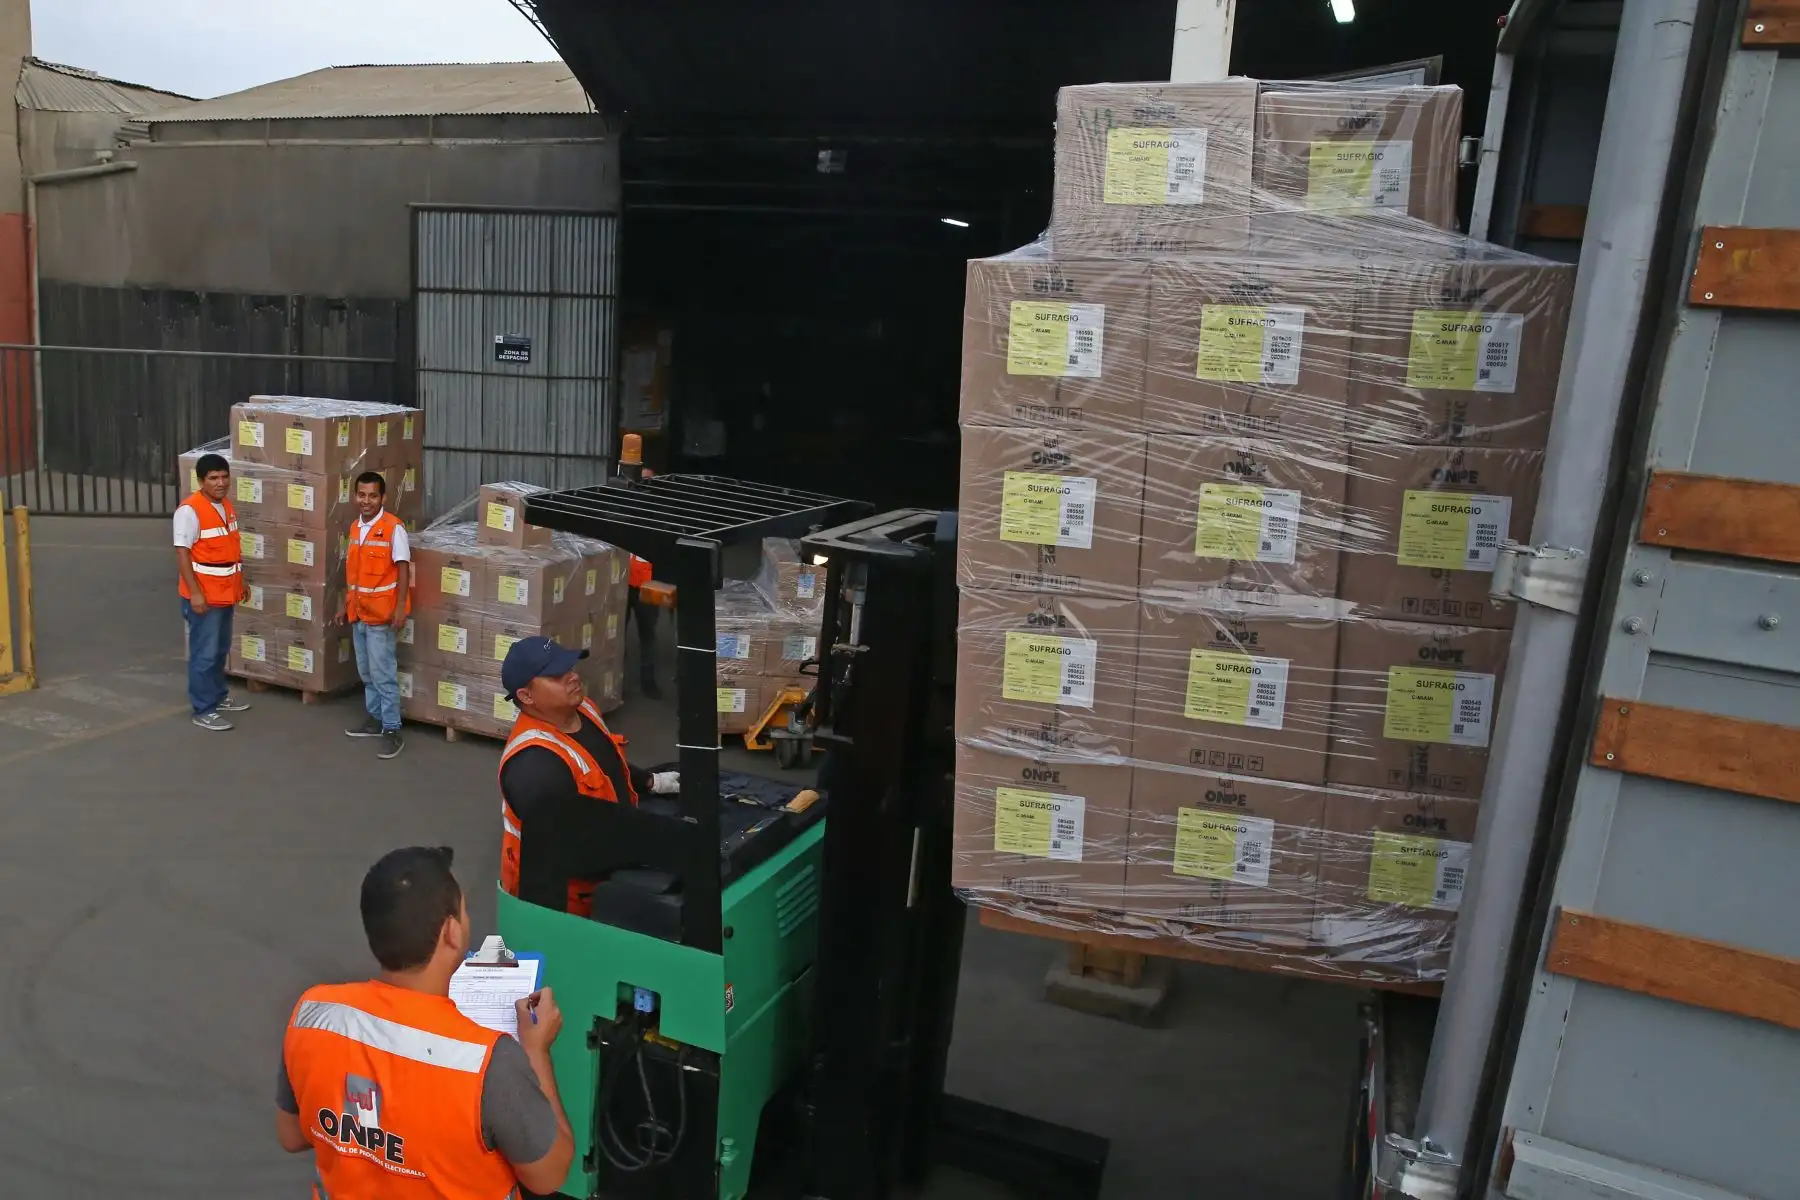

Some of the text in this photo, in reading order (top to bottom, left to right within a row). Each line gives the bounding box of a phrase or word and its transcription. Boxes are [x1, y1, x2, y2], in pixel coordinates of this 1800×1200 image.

[1337, 153, 1384, 161] SUFRAGIO
[1035, 314, 1078, 322] SUFRAGIO
[1228, 318, 1276, 327] SUFRAGIO
[1441, 324, 1492, 333] SUFRAGIO
[1432, 469, 1478, 483] ONPE
[1028, 485, 1070, 494] SUFRAGIO
[1226, 498, 1272, 508] SUFRAGIO
[1432, 504, 1481, 514] SUFRAGIO
[1029, 645, 1071, 655] SUFRAGIO
[1418, 647, 1464, 663] ONPE
[1216, 663, 1261, 674] SUFRAGIO
[1416, 680, 1465, 691] SUFRAGIO
[1022, 768, 1060, 783] ONPE
[1205, 790, 1246, 806] ONPE
[1020, 800, 1060, 811] SUFRAGIO
[1203, 822, 1247, 833] SUFRAGIO
[1401, 847, 1448, 859] SUFRAGIO
[318, 1107, 404, 1165] ONPE
[384, 1162, 426, 1178] ELECTORALES
